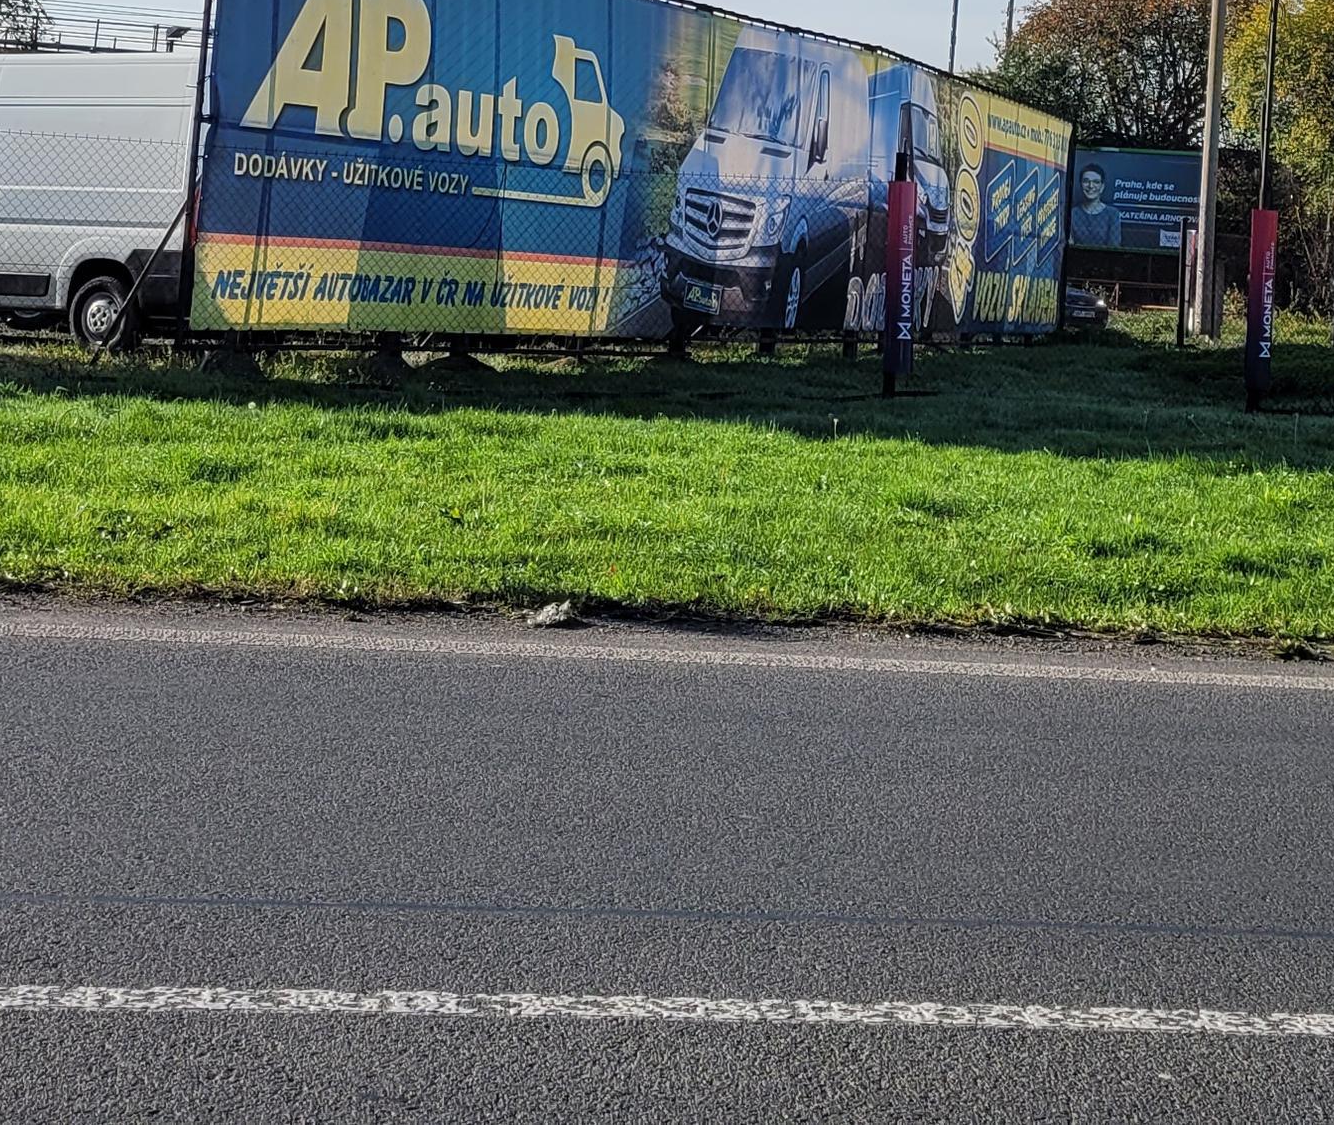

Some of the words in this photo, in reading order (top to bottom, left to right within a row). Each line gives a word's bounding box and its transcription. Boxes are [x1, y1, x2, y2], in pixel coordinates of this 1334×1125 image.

[234, 152, 327, 181] DODÁVKY
[343, 158, 423, 190] UŽITKOVÉ
[428, 171, 469, 194] VOZY
[1115, 179, 1144, 191] Praha,
[1146, 180, 1162, 190] kde
[1113, 190, 1147, 202] plánuje
[211, 262, 315, 300] NEJVĚTŠÍ
[313, 272, 416, 306] AUTOBAZAR
[420, 278, 435, 304] V
[436, 270, 459, 308] ČR
[462, 280, 486, 307] NA
[490, 274, 566, 310] UŽITKOVÉ
[901, 255, 913, 317] MONETA
[1262, 279, 1274, 337] MONETA
